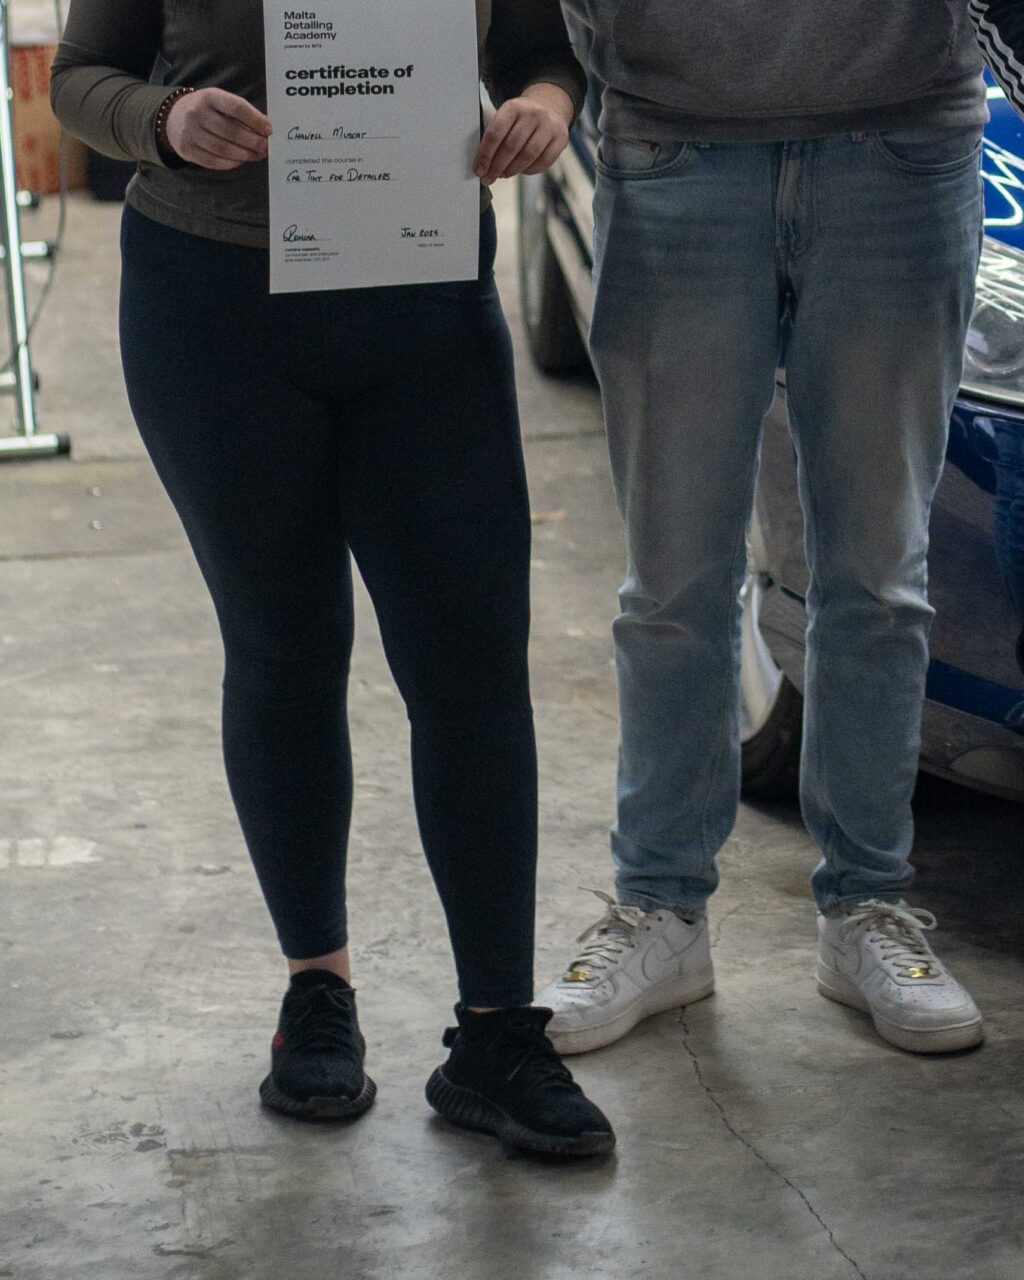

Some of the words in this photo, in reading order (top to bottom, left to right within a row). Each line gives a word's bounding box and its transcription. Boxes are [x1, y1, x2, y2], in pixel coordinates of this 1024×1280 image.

[284, 10, 316, 20] Malta
[284, 20, 333, 31] Detailing
[284, 31, 337, 41] Academy
[285, 64, 389, 80] certificate
[393, 64, 414, 78] of
[285, 80, 395, 98] completion
